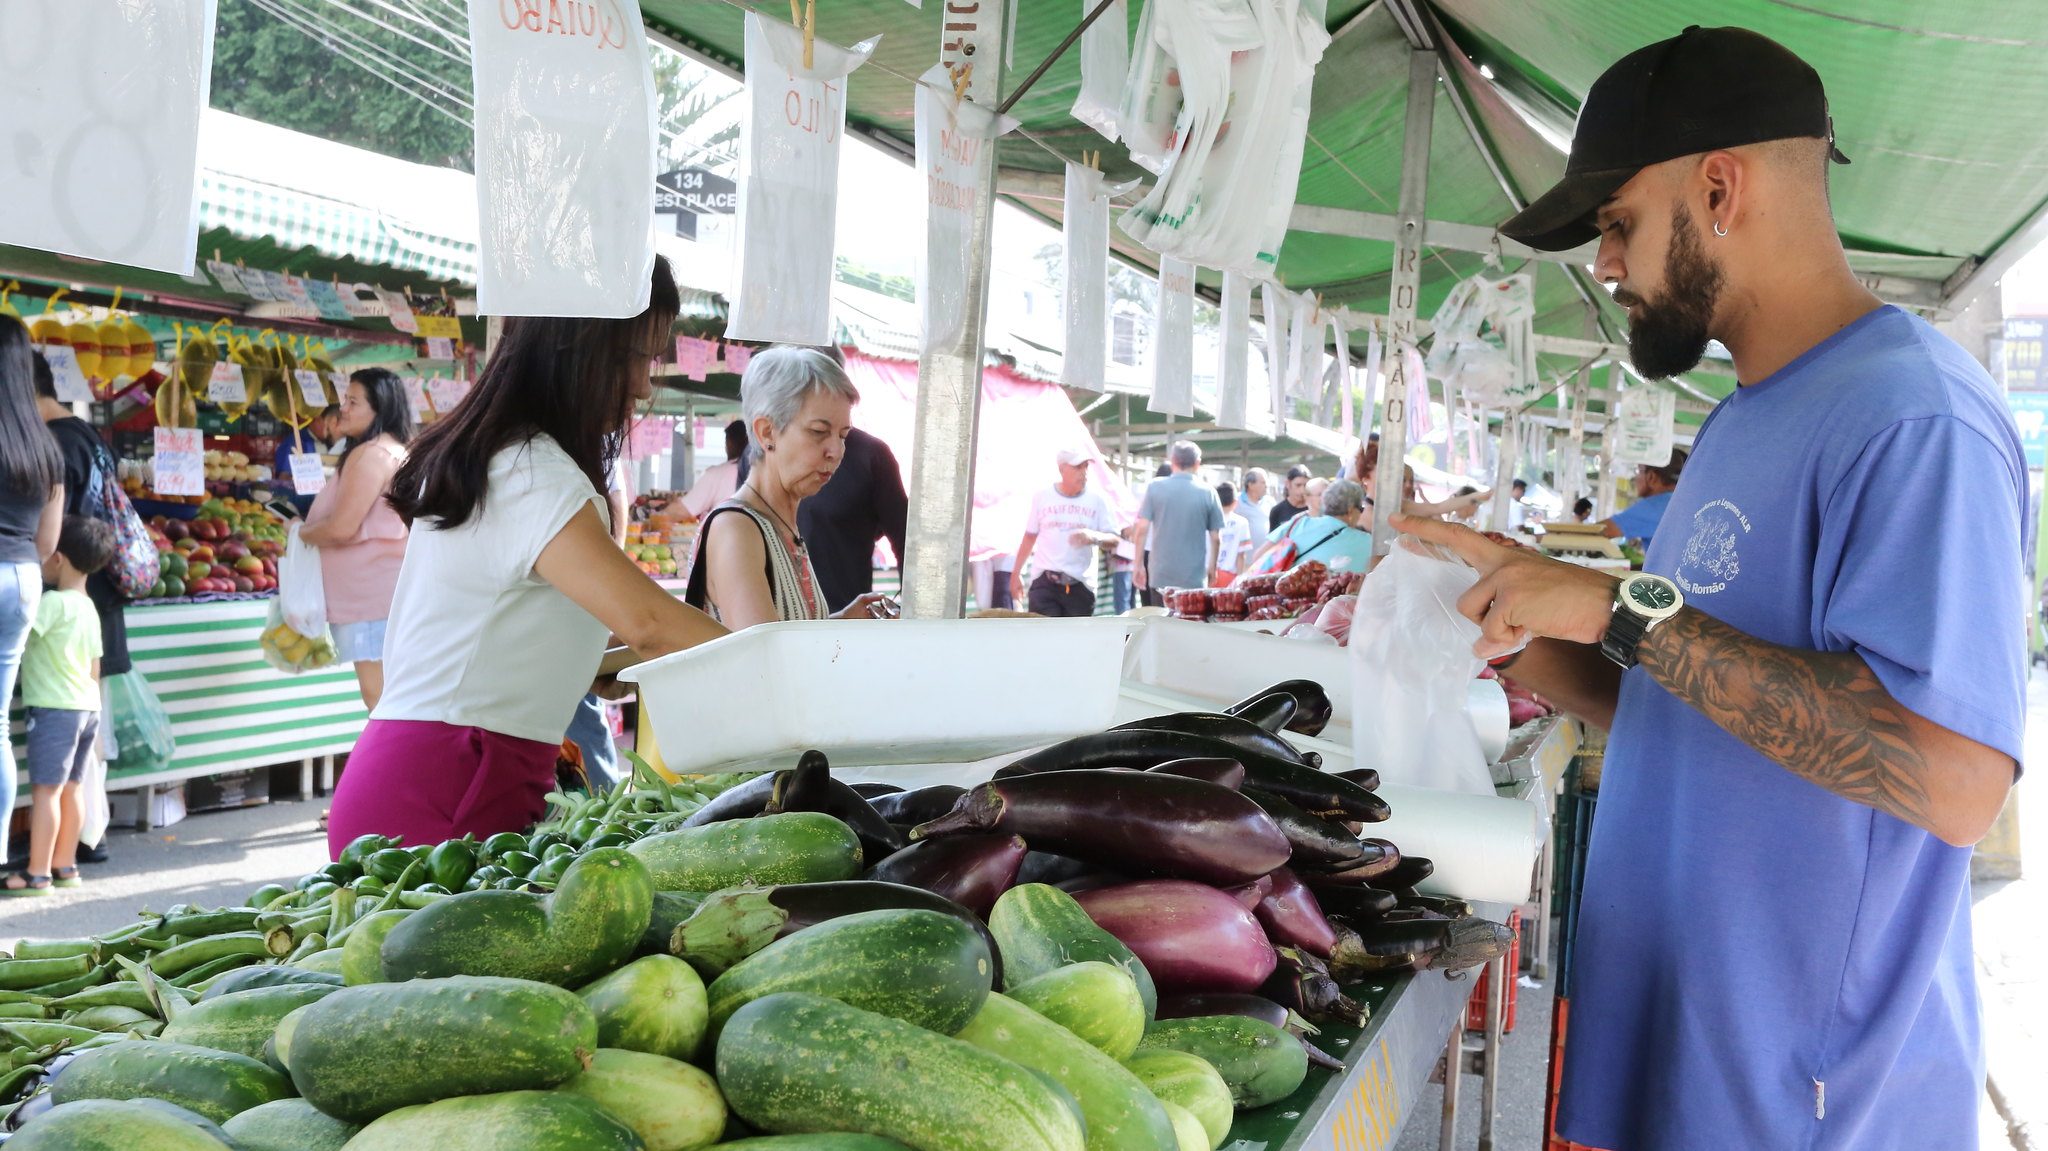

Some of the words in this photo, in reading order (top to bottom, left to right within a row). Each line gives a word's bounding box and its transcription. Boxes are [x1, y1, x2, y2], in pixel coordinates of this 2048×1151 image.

[674, 172, 704, 189] 134
[686, 193, 737, 208] PLACE
[1739, 515, 1751, 534] ALR
[1691, 582, 1726, 595] Romão
